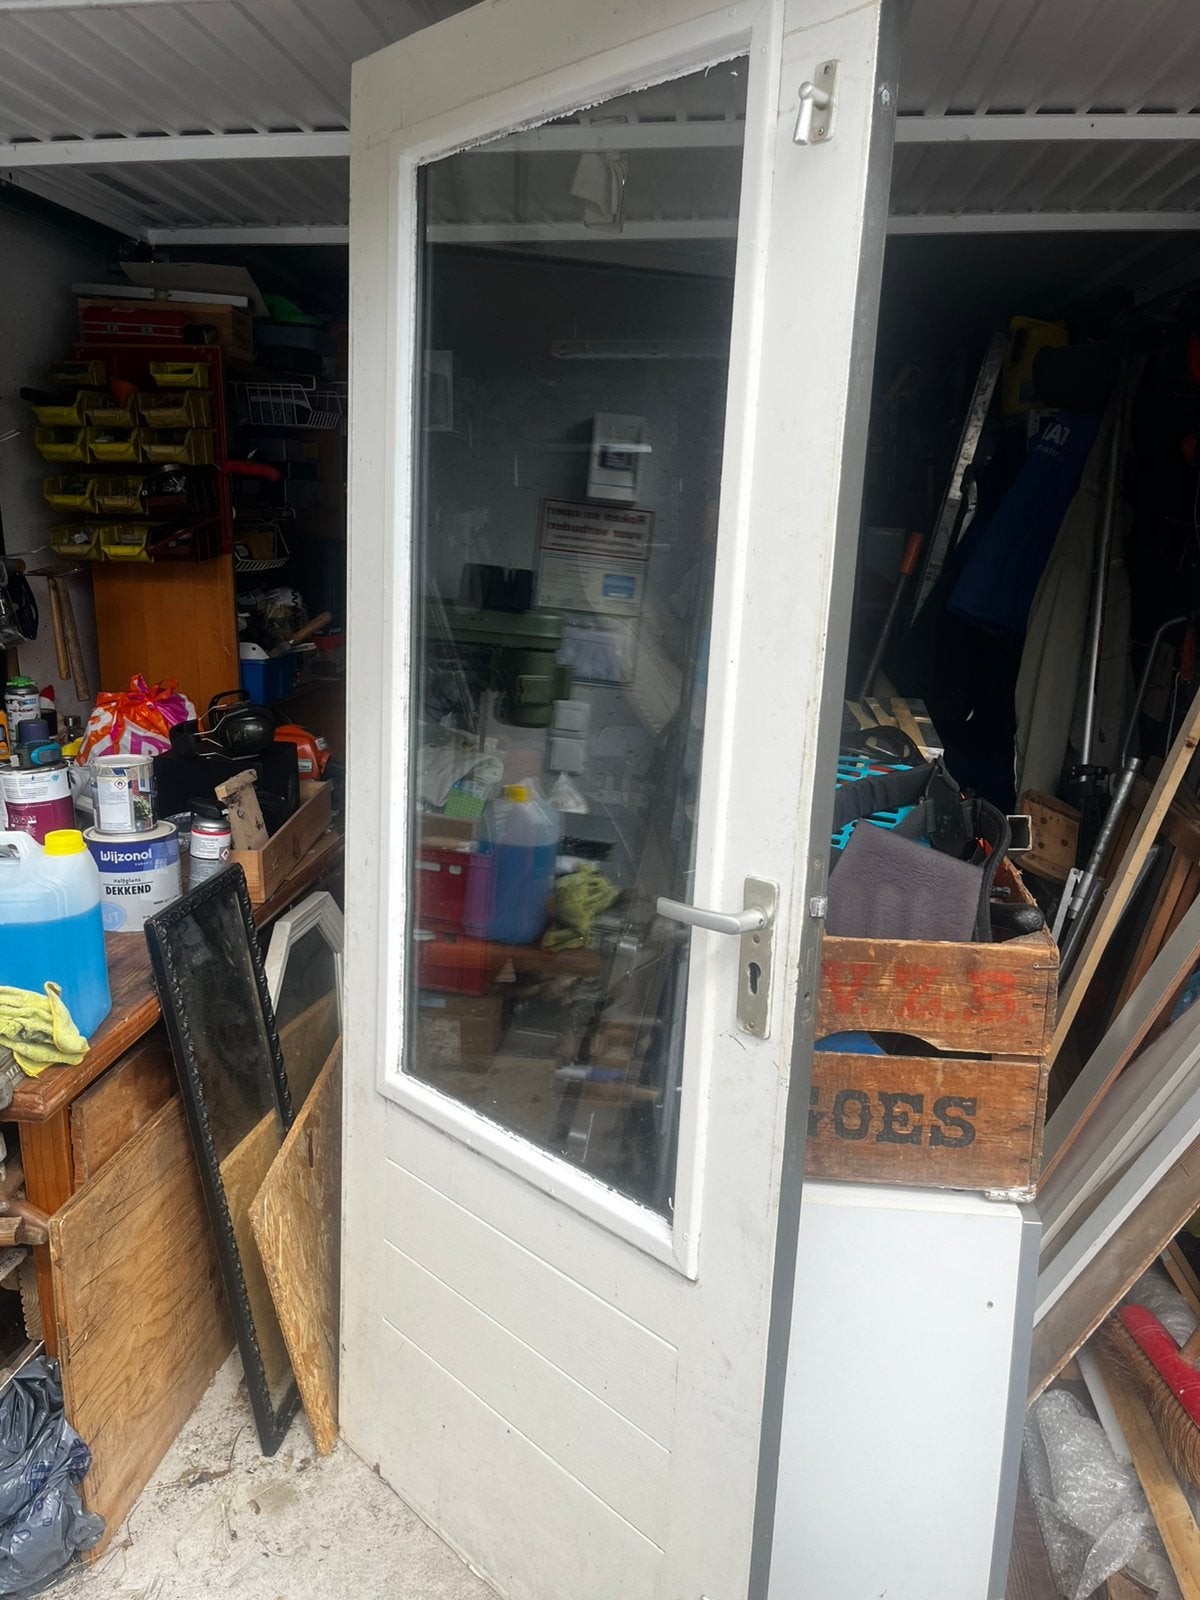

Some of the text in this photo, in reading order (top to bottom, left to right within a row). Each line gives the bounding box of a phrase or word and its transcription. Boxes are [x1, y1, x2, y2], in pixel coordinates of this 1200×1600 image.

[100, 848, 152, 863] Wijzonol
[105, 884, 151, 895] DEKKEND
[807, 1086, 978, 1148] OES
